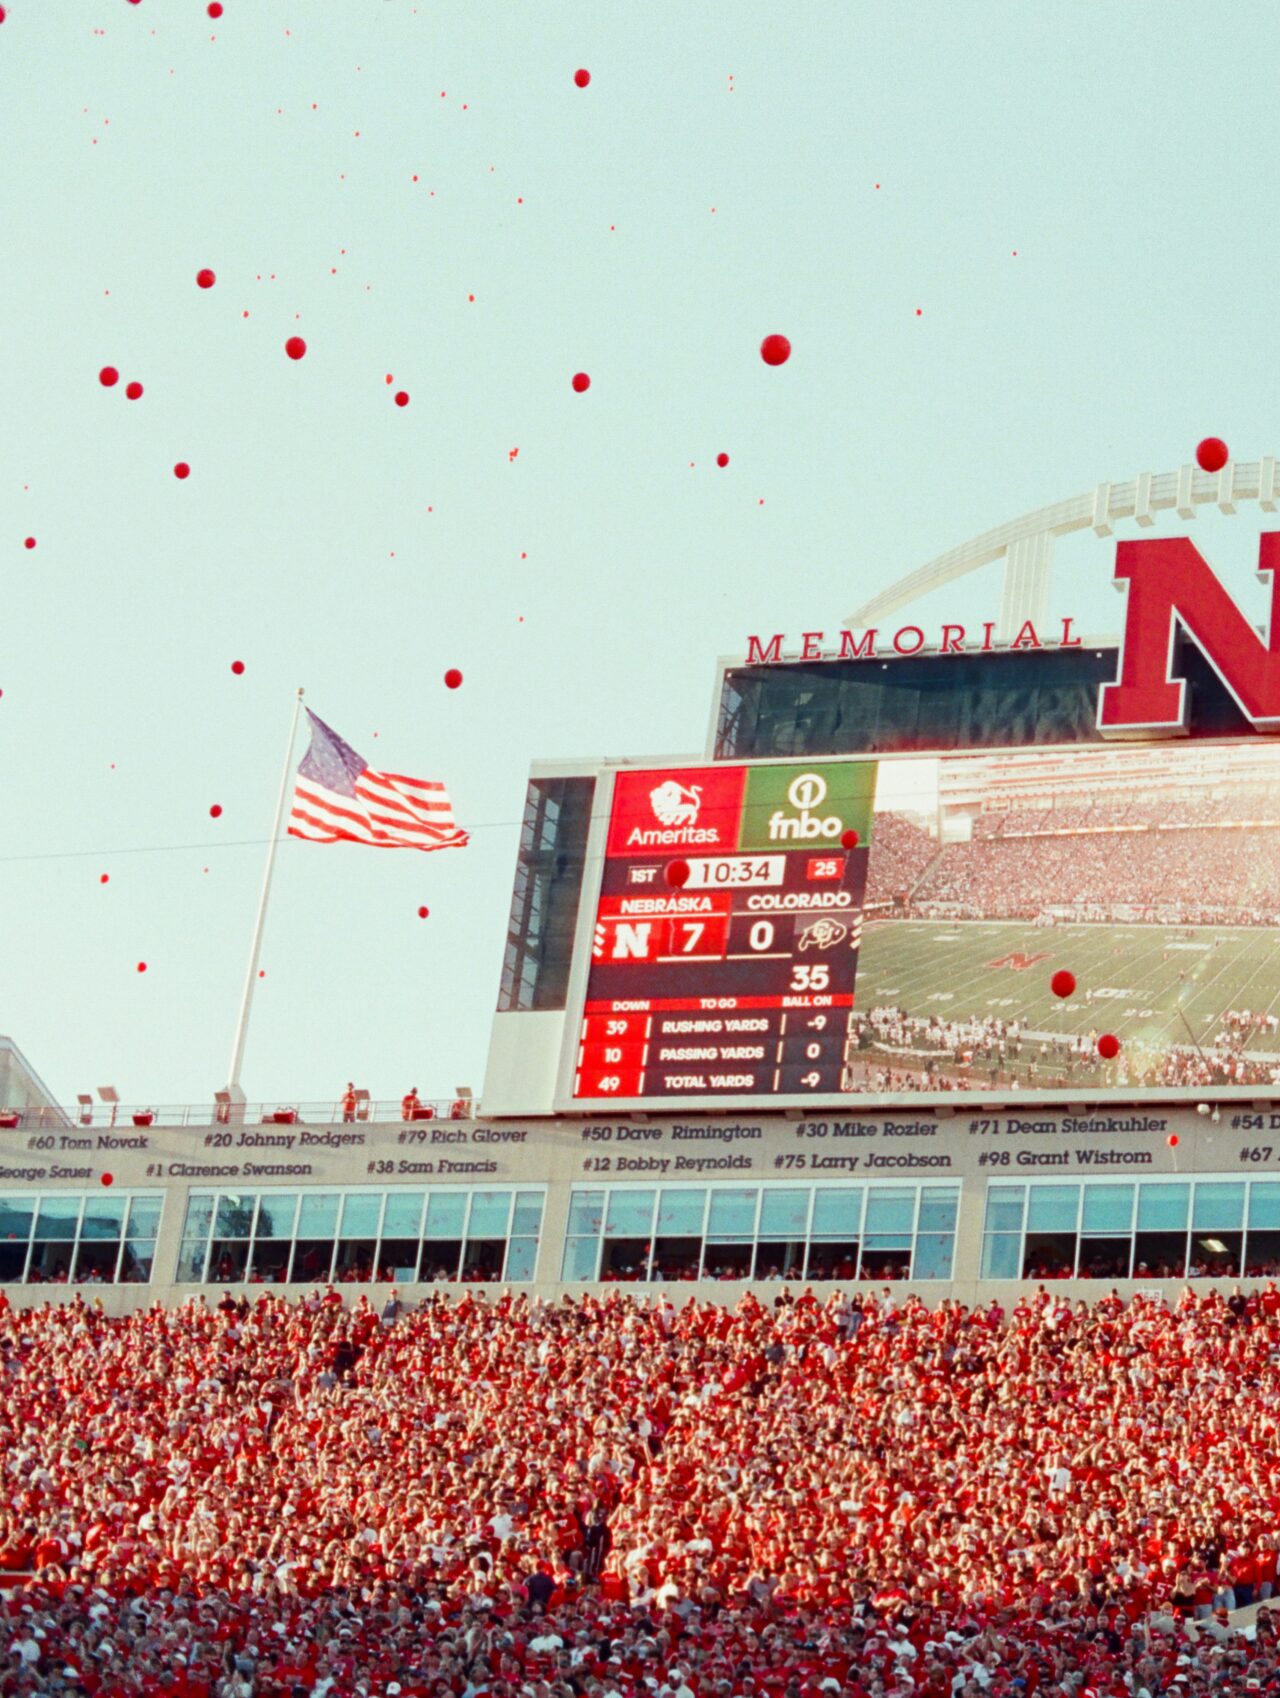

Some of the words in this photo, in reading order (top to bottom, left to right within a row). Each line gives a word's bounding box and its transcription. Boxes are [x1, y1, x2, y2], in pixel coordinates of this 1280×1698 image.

[745, 618, 1083, 665] MEMORIAL
[768, 810, 843, 840] fnbo
[631, 868, 657, 883] 1ST
[702, 861, 771, 883] 10:34
[813, 861, 837, 877] 25
[620, 897, 713, 914] NEBRASKA
[747, 891, 852, 911] COLORADO
[611, 923, 652, 959] N
[682, 923, 705, 952] 7
[750, 920, 775, 951] 0
[790, 964, 830, 991] 35
[612, 999, 650, 1013] DOWN
[700, 998, 717, 1010] TO
[718, 997, 737, 1009] GO
[782, 996, 808, 1008] BALL
[809, 995, 833, 1007] ON
[606, 1020, 628, 1036] 39
[662, 1019, 722, 1034] RUSHING
[724, 1017, 769, 1032] YARDS
[807, 1016, 827, 1031] -9
[604, 1048, 622, 1064] 10
[659, 1047, 717, 1062] PASSING
[719, 1045, 765, 1060] YARDS
[807, 1043, 820, 1059] 0
[598, 1076, 620, 1091] 49
[665, 1075, 707, 1089] TOTAL
[709, 1074, 755, 1088] YARDS
[800, 1072, 821, 1088] -9
[795, 1123, 828, 1138] #30
[833, 1122, 878, 1137] Mike
[882, 1121, 939, 1137] Rozier
[968, 1119, 1000, 1135] #71
[1006, 1118, 1057, 1135] Dean
[1061, 1117, 1168, 1133] Steinkuhler
[1230, 1114, 1264, 1130] #54
[27, 1135, 55, 1150] #60
[60, 1136, 92, 1150] Tom
[97, 1134, 149, 1150] Novak
[204, 1133, 232, 1148] #20
[236, 1132, 296, 1149] Johnny
[300, 1131, 366, 1148] Rodgers
[397, 1129, 427, 1145] #79
[431, 1128, 468, 1144] Rich
[471, 1128, 528, 1142] Glover
[581, 1126, 612, 1141] #50
[615, 1126, 663, 1140] Dave
[671, 1124, 763, 1143] Rimington
[773, 1154, 806, 1169] #75
[811, 1153, 858, 1172] Larry
[863, 1152, 952, 1168] Jacobson
[978, 1151, 1010, 1167] #98
[1016, 1150, 1070, 1166] Grant
[1075, 1149, 1153, 1165] Wistrom
[1239, 1146, 1273, 1162] #67
[49, 1164, 93, 1179] Sauer
[146, 1162, 163, 1178] #1
[168, 1162, 239, 1177] Clarence
[243, 1160, 312, 1176] Swanson
[367, 1160, 394, 1175] #38
[397, 1159, 434, 1174] Sam
[438, 1158, 498, 1174] Francis
[582, 1156, 611, 1172] #12
[616, 1155, 670, 1173] Bobby
[674, 1154, 752, 1173] Reynolds
